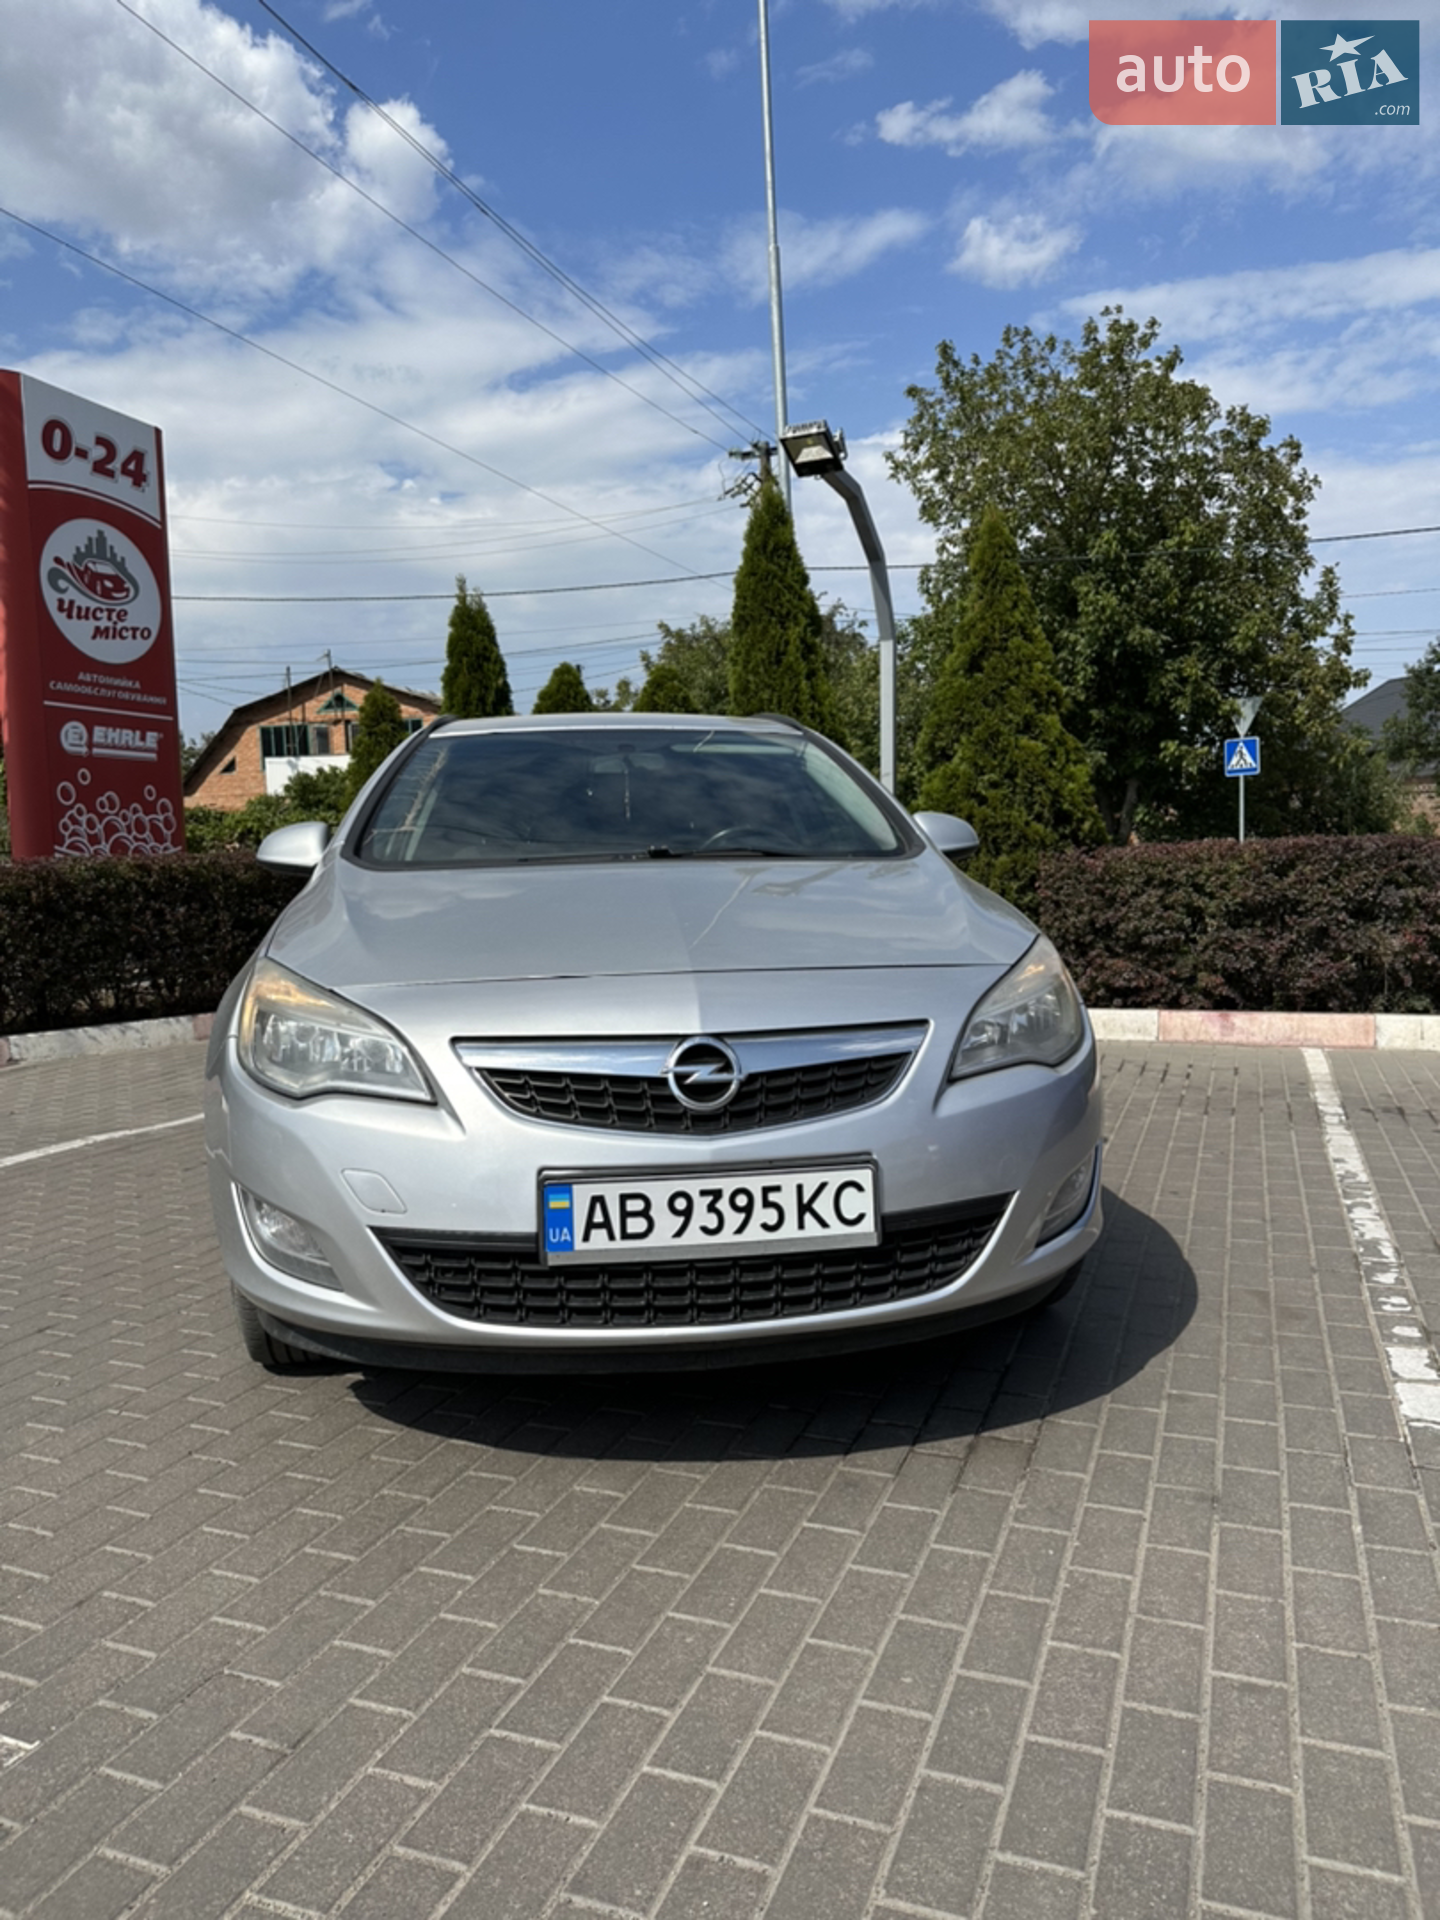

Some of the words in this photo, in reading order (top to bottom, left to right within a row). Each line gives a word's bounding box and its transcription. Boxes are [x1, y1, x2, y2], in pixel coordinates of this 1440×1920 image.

[41, 418, 148, 489] 0-24
[56, 598, 128, 622] Чисте
[91, 621, 152, 641] місто
[93, 725, 158, 749] EHRLE
[582, 1192, 655, 1242] AB
[667, 1184, 785, 1238] 9395
[796, 1180, 866, 1230] KC
[549, 1228, 571, 1243] UA
